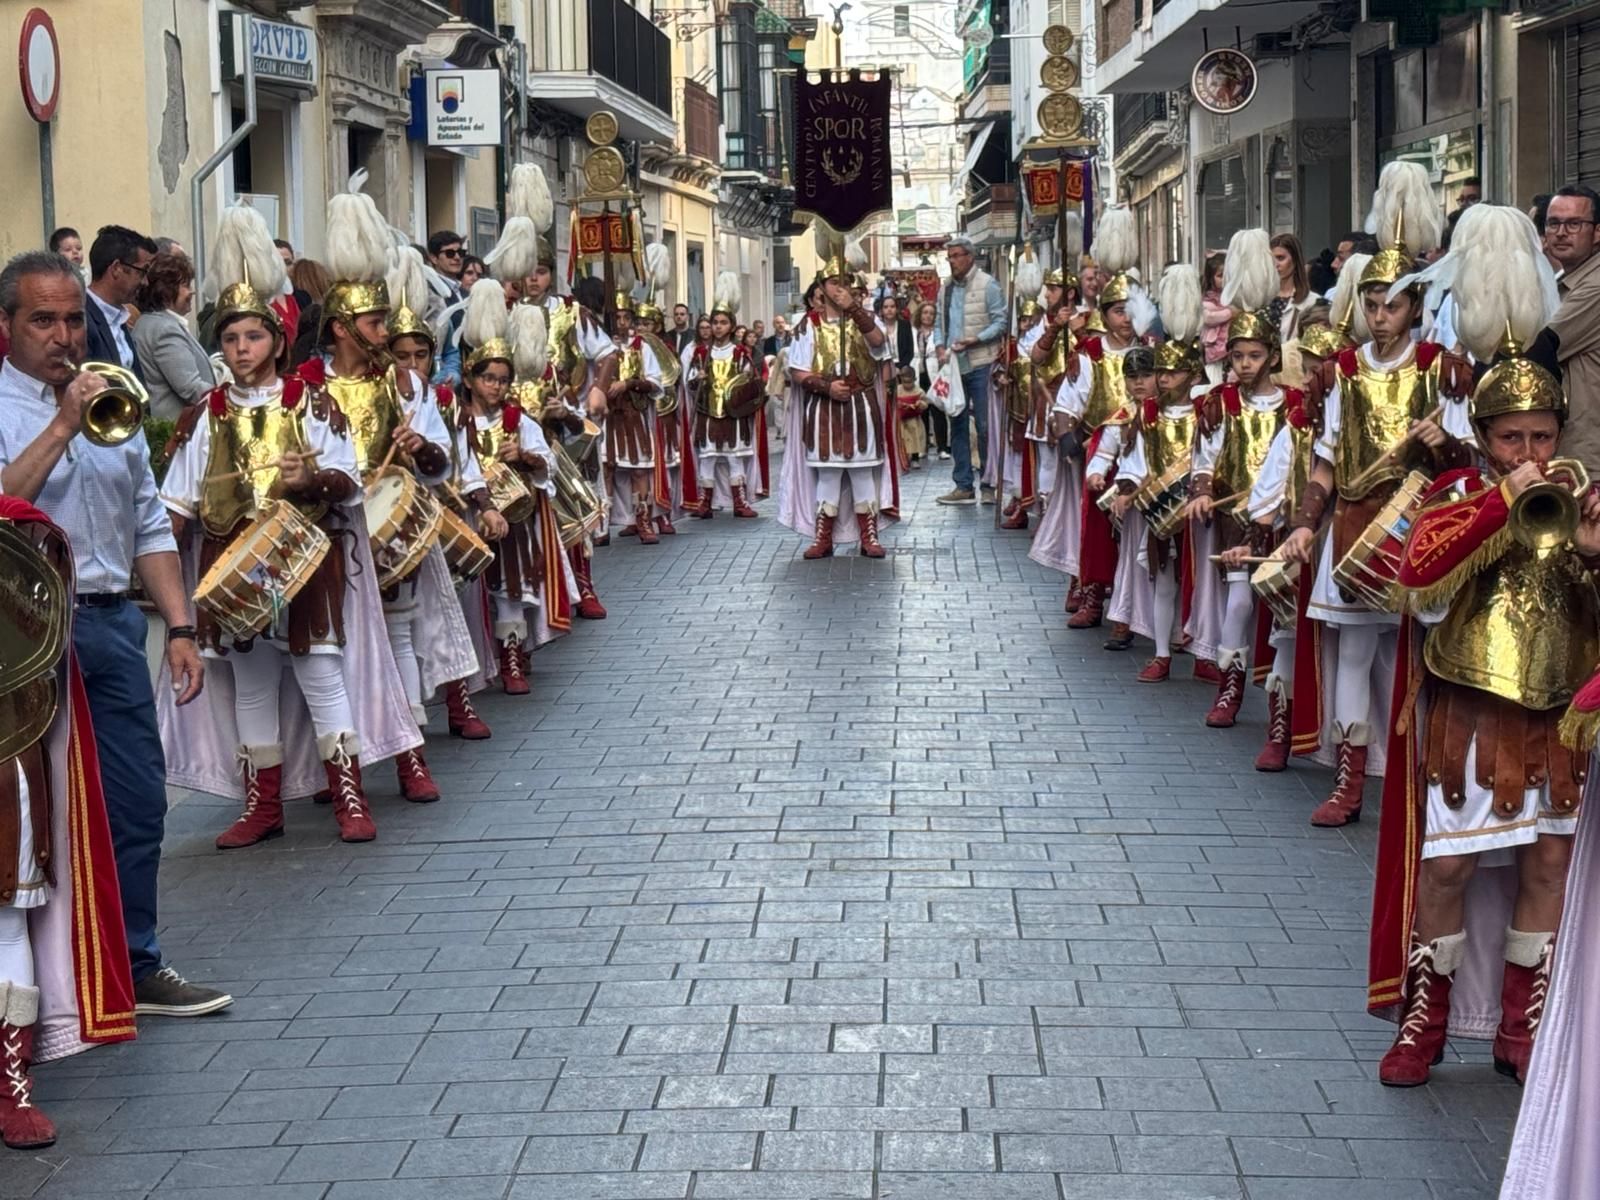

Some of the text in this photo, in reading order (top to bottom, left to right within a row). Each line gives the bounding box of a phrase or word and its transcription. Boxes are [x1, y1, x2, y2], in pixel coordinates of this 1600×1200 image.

[807, 89, 868, 117] INFANTIL
[437, 122, 485, 133] Apuestas del
[437, 132, 463, 141] Estado
[814, 117, 867, 141] SPQR
[870, 116, 884, 191] ROMANA
